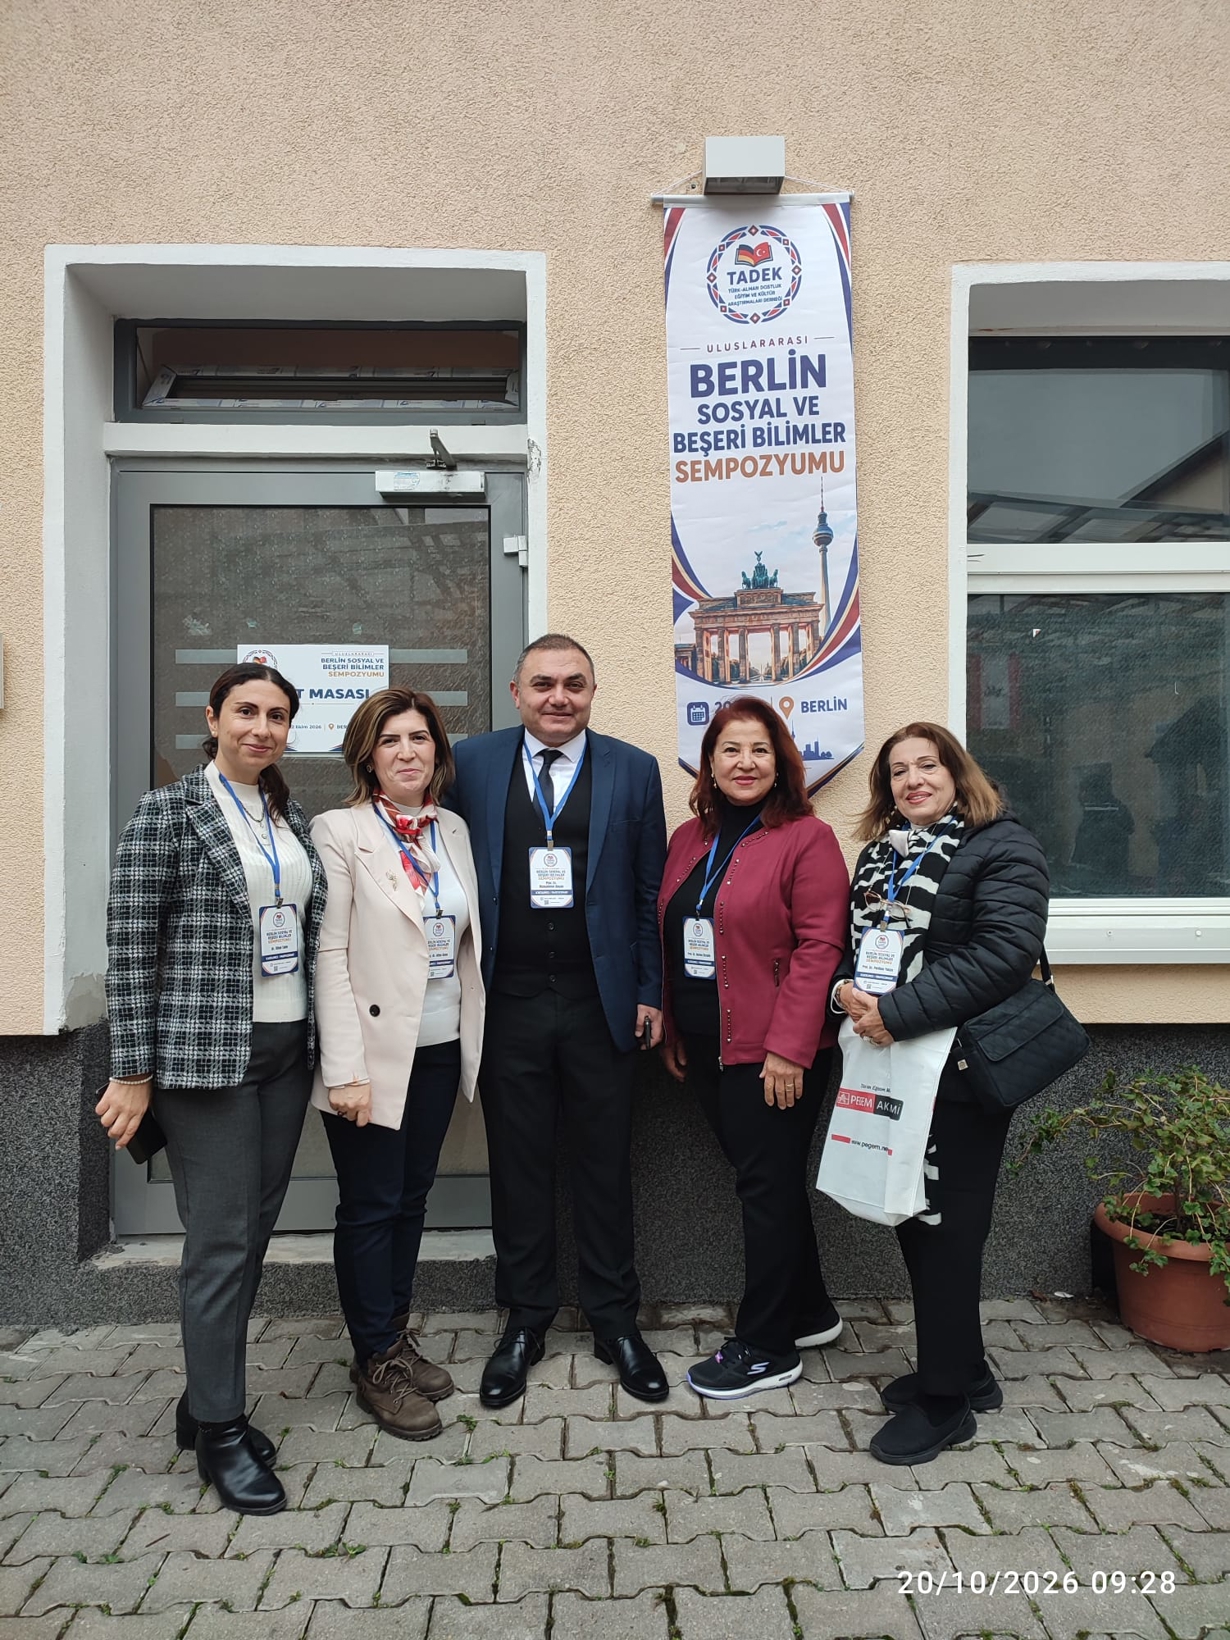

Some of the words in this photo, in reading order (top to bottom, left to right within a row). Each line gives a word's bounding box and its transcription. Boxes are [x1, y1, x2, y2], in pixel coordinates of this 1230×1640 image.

[726, 266, 783, 286] TADEK
[706, 335, 809, 353] ULUSLARARASI
[690, 348, 827, 398] BERLİN
[697, 397, 788, 425] SOSYAL
[792, 395, 820, 417] VE
[673, 424, 746, 458] BEŞERİ
[752, 420, 847, 448] BİLİMLER
[675, 450, 845, 483] SEMPOZYUMU
[320, 656, 346, 664] BERLİN
[309, 688, 370, 700] MASASI
[800, 695, 848, 714] BERLİN
